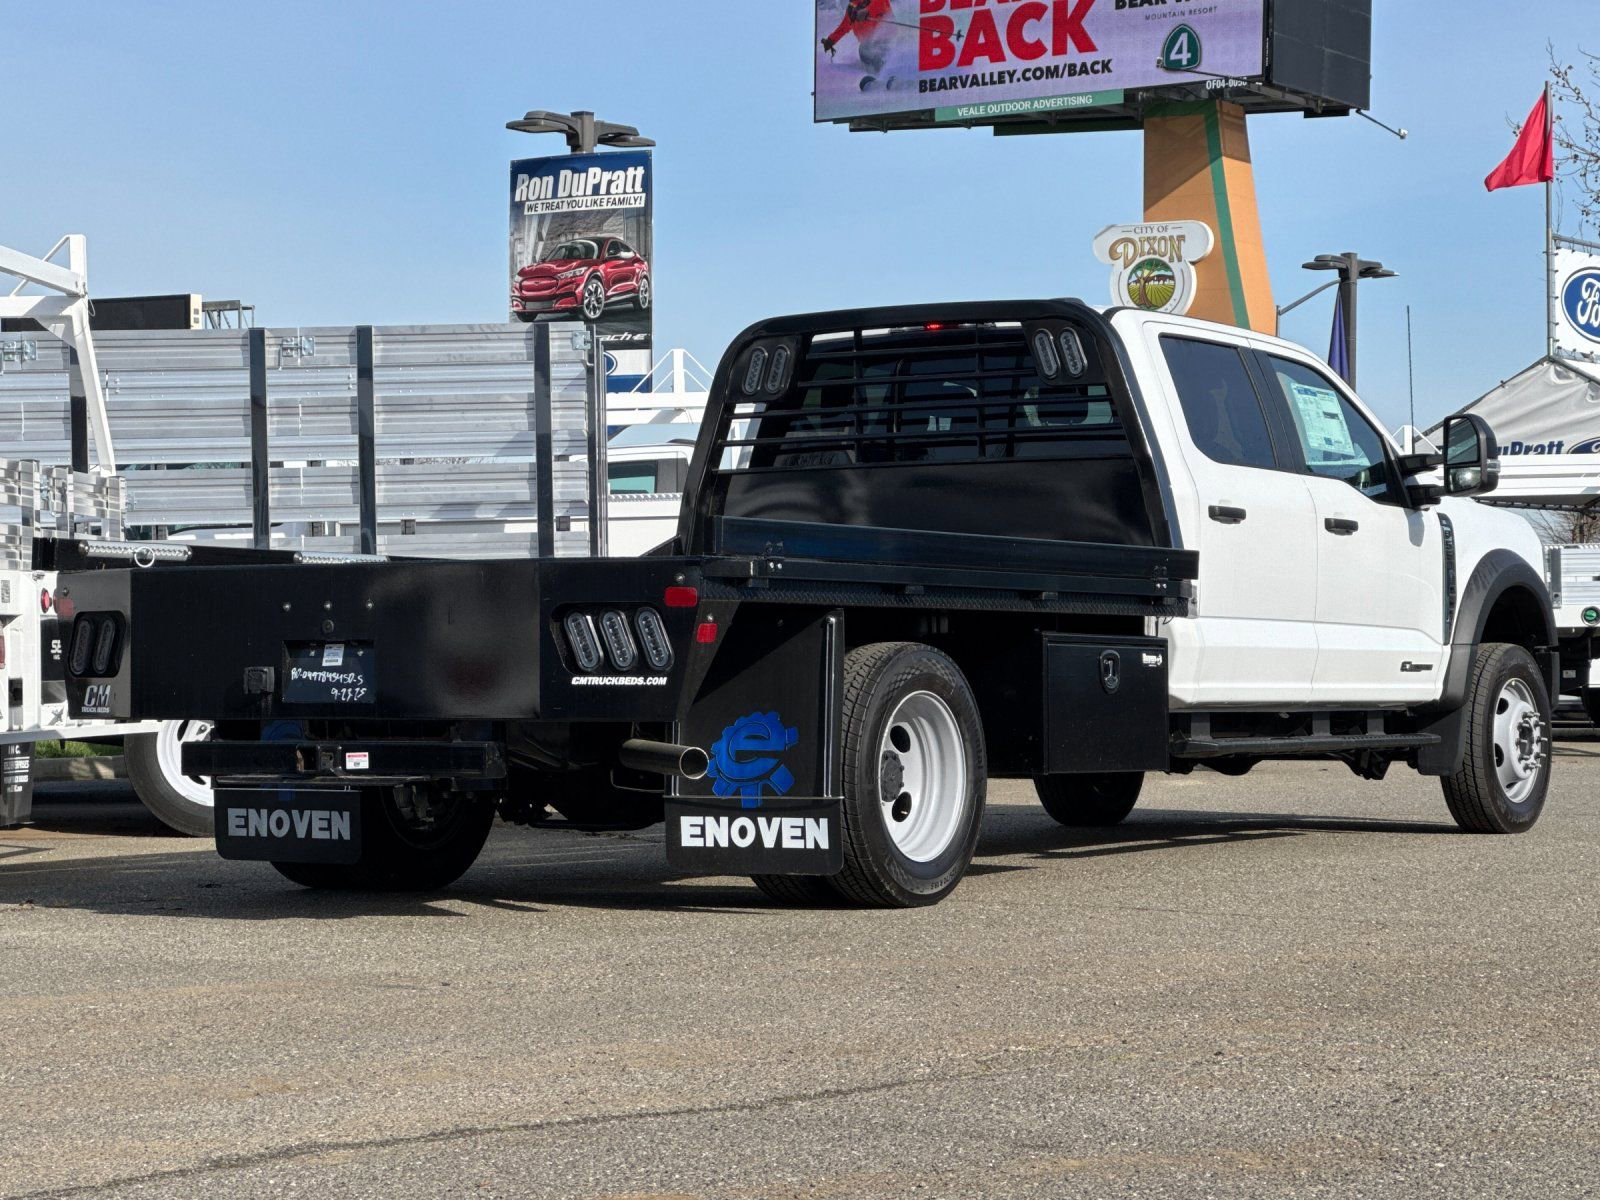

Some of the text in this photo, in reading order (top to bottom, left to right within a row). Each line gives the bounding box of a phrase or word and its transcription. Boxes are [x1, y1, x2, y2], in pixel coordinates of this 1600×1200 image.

[1145, 6, 1218, 20] MOUNTAIN RESORT
[918, 0, 1099, 71] BACK
[1169, 32, 1192, 66] 4
[919, 58, 1113, 93] BEARVALLEY.COM/BACK
[957, 95, 1093, 117] VEALE OUTDOOR ADVERTISING
[515, 166, 645, 202] Ron DuPratt
[526, 195, 643, 213] WE TREAT YOU LIKE FAMILY!
[1133, 225, 1169, 234] CITY OF
[1497, 441, 1565, 455] uPratt
[571, 676, 668, 686] CMTRUCKBEDS.COM
[84, 685, 111, 707] CM
[227, 807, 351, 841] ENOVEN
[680, 815, 829, 850] ENOVEN
